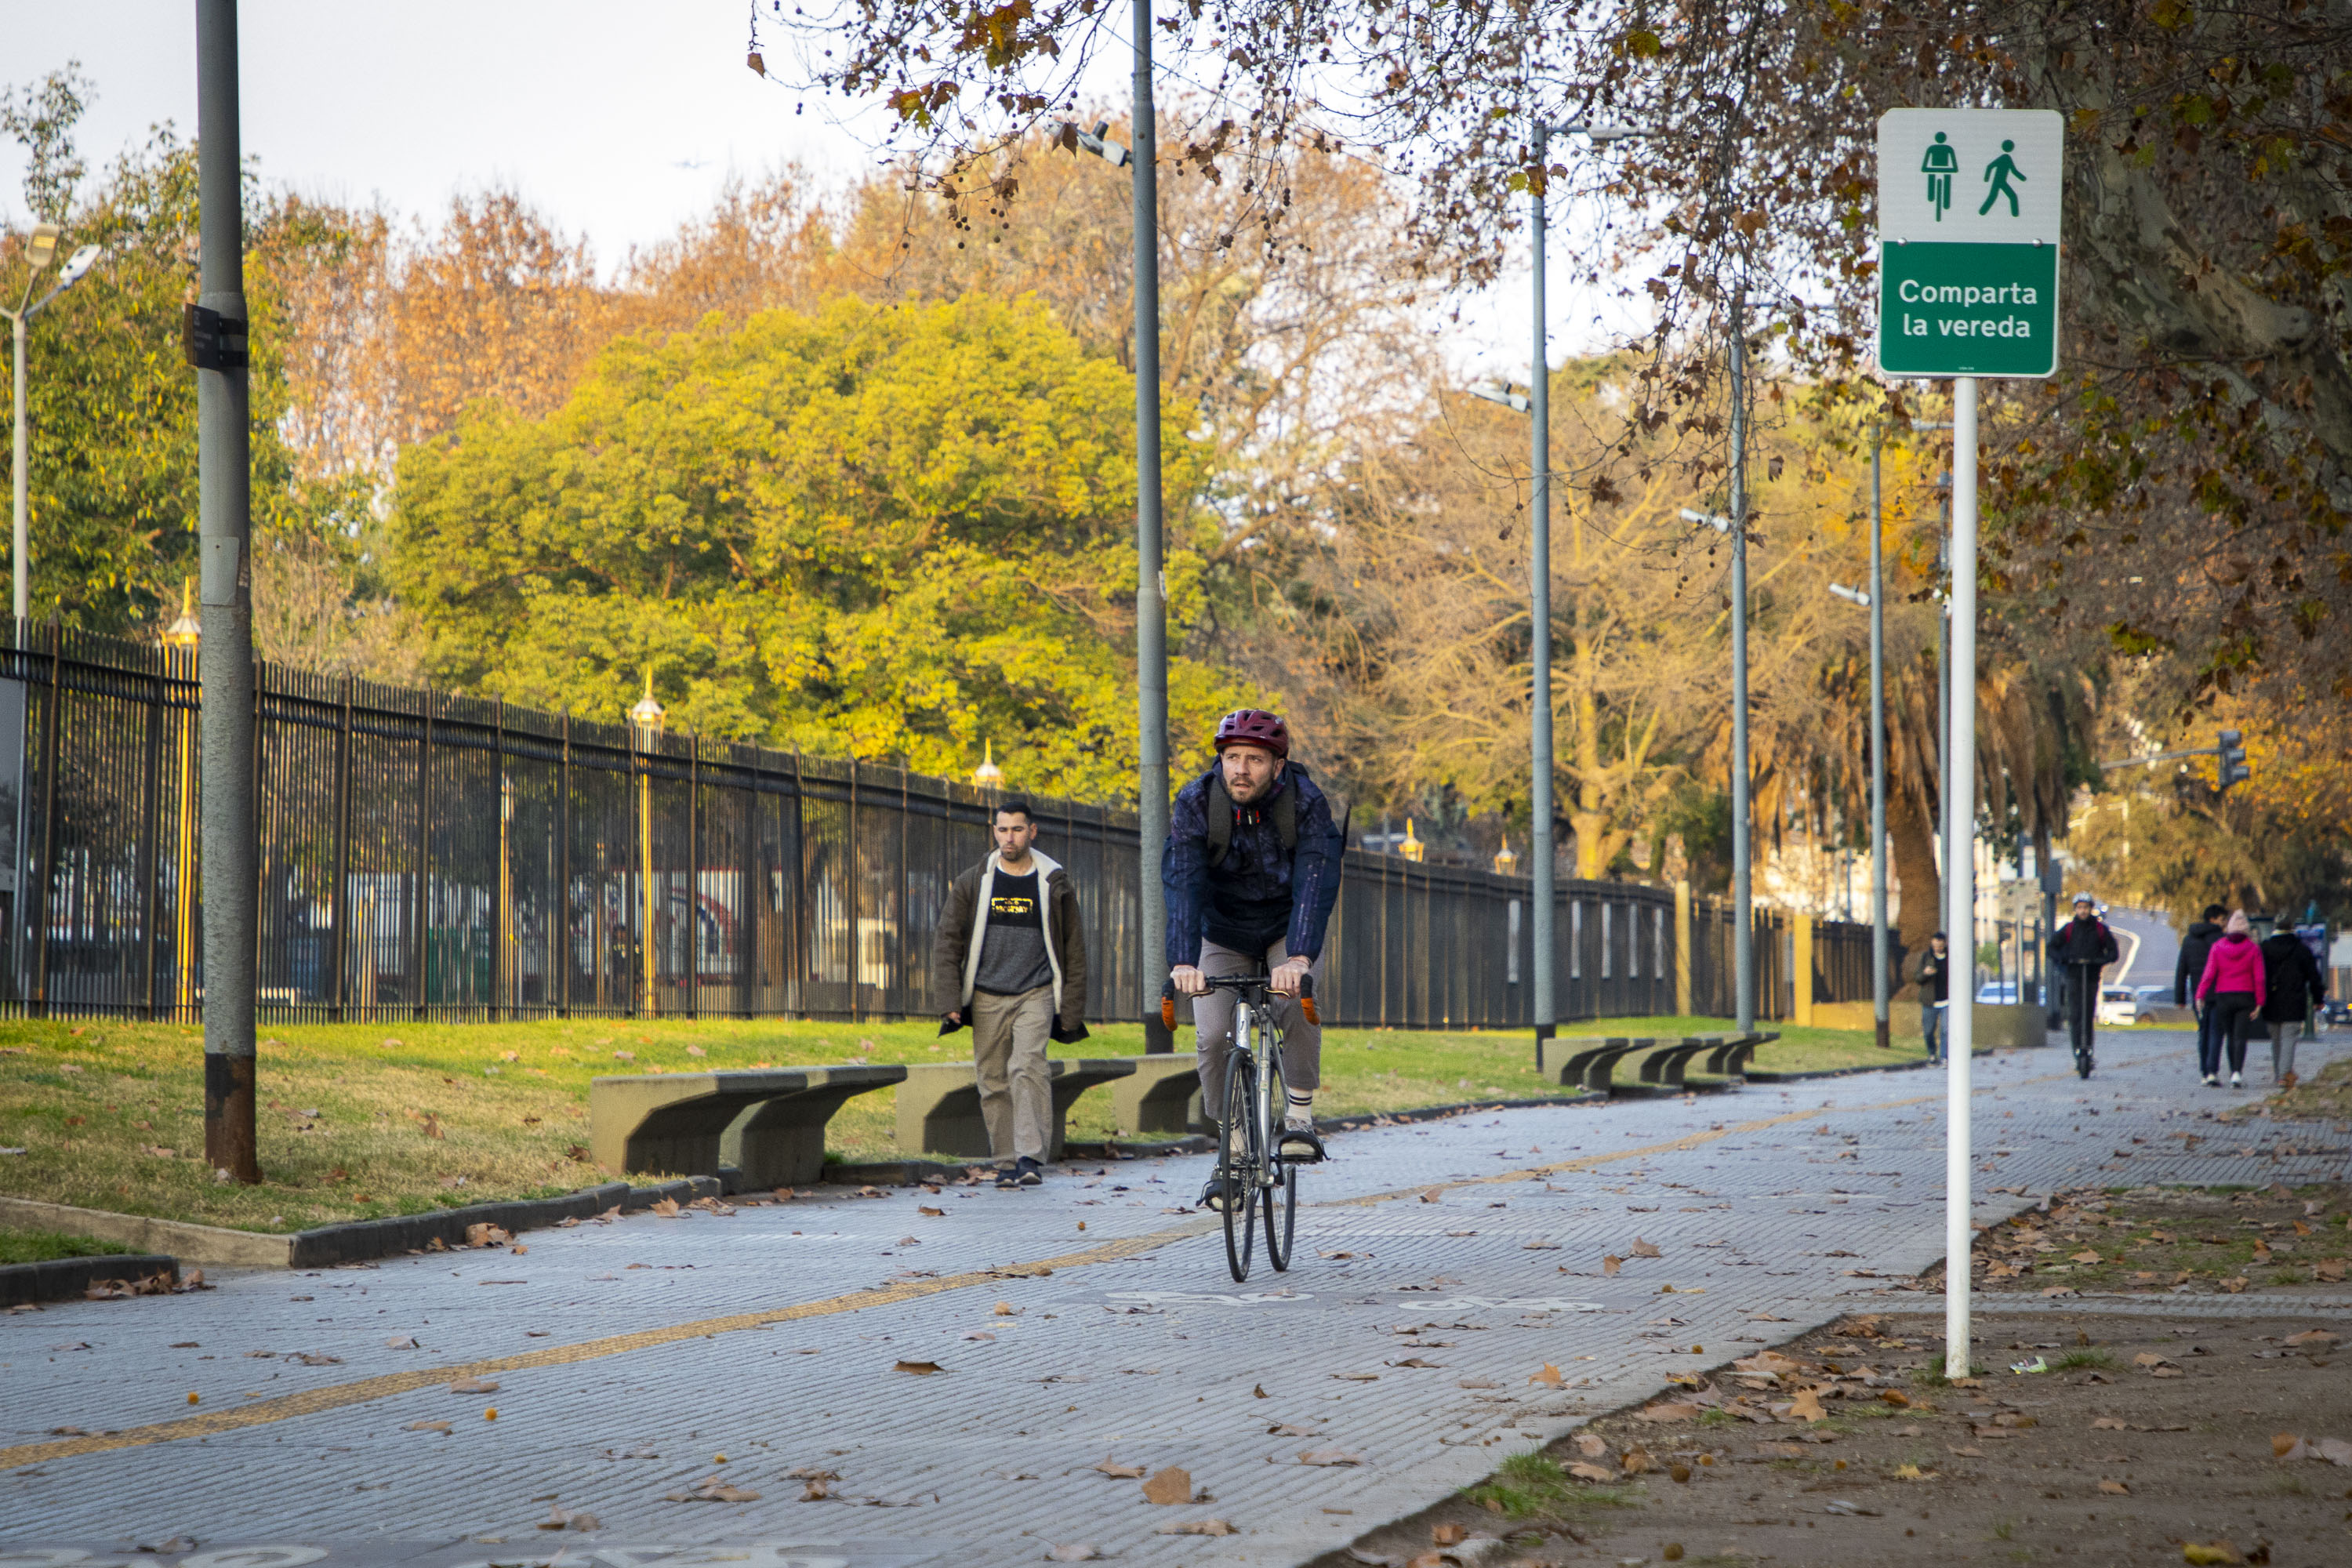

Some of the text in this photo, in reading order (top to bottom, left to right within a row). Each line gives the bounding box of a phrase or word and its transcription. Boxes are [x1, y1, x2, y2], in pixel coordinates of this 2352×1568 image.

[1899, 279, 2038, 307] Comparta
[1904, 313, 2031, 338] la vereda
